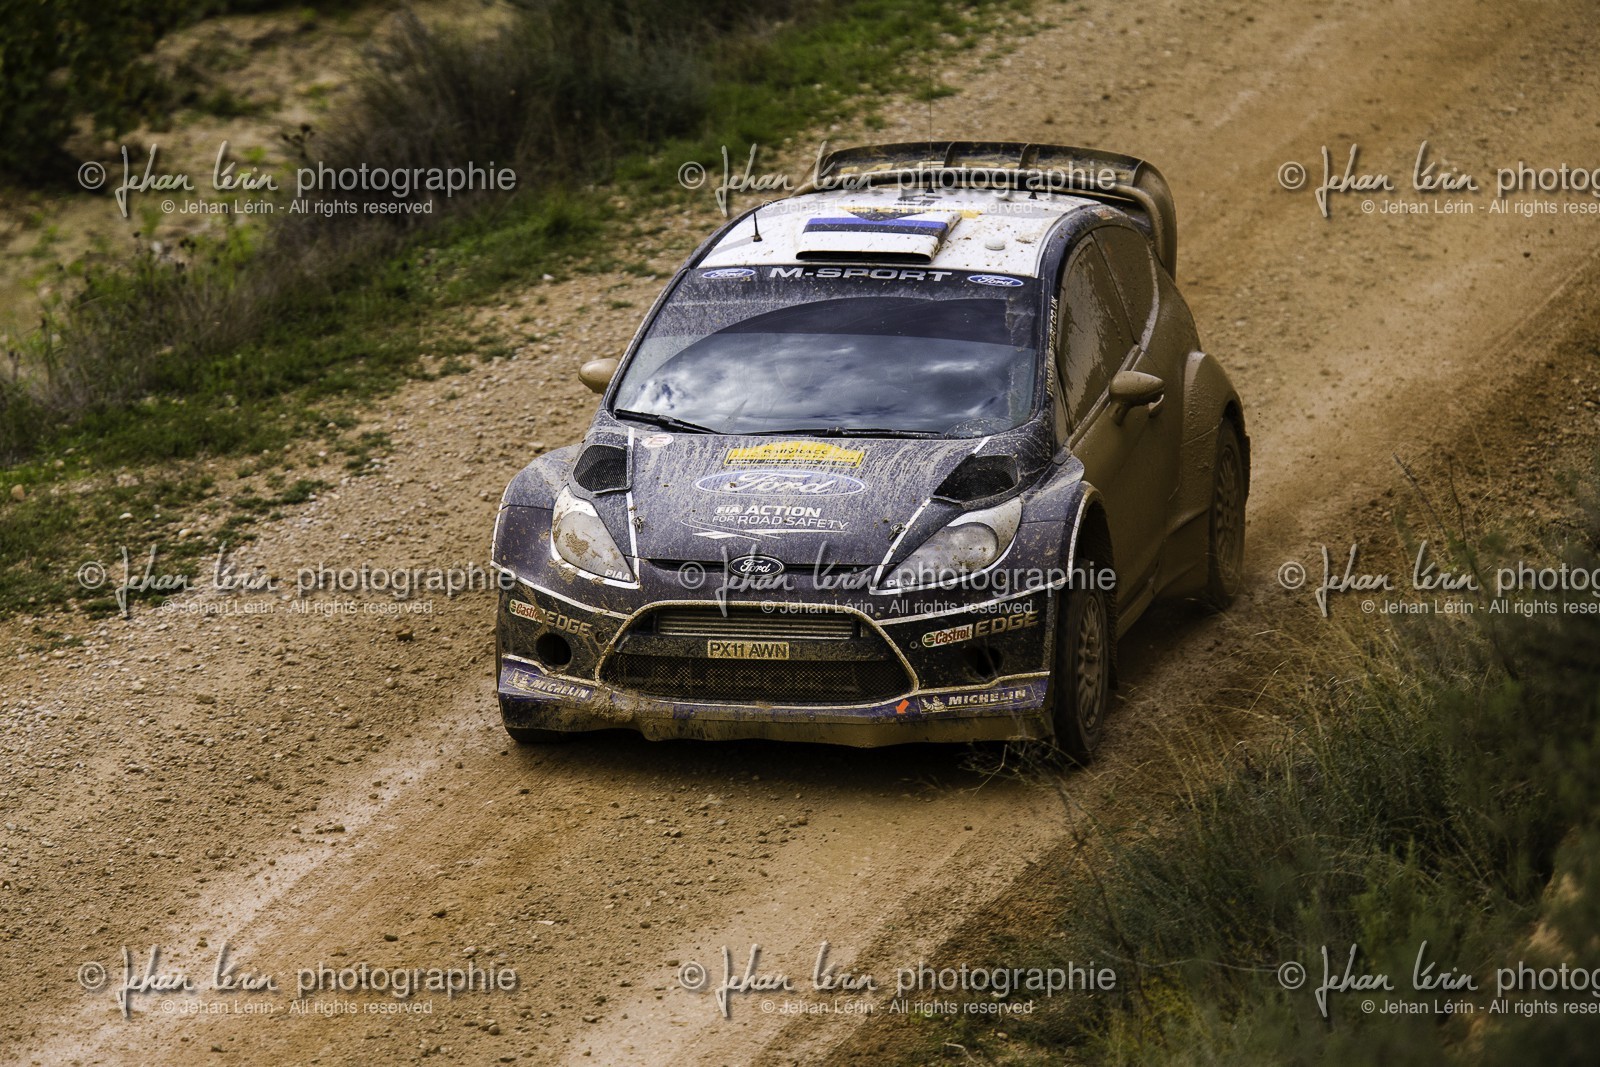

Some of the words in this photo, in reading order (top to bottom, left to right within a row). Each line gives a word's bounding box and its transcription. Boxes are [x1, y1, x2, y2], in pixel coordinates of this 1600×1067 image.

[768, 267, 952, 282] M-SPORT
[723, 472, 837, 494] Ford
[744, 505, 822, 517] ACTION
[712, 515, 735, 523] FOR
[737, 516, 781, 525] ROAD
[785, 517, 849, 530] SAFETY
[604, 569, 630, 581] PIAA
[545, 610, 593, 637] EDGE
[935, 626, 970, 644] Castrol
[974, 610, 1039, 637] EDGE
[709, 642, 744, 656] PX11
[749, 643, 786, 657] AWN
[948, 689, 1026, 706] MICHELIN
